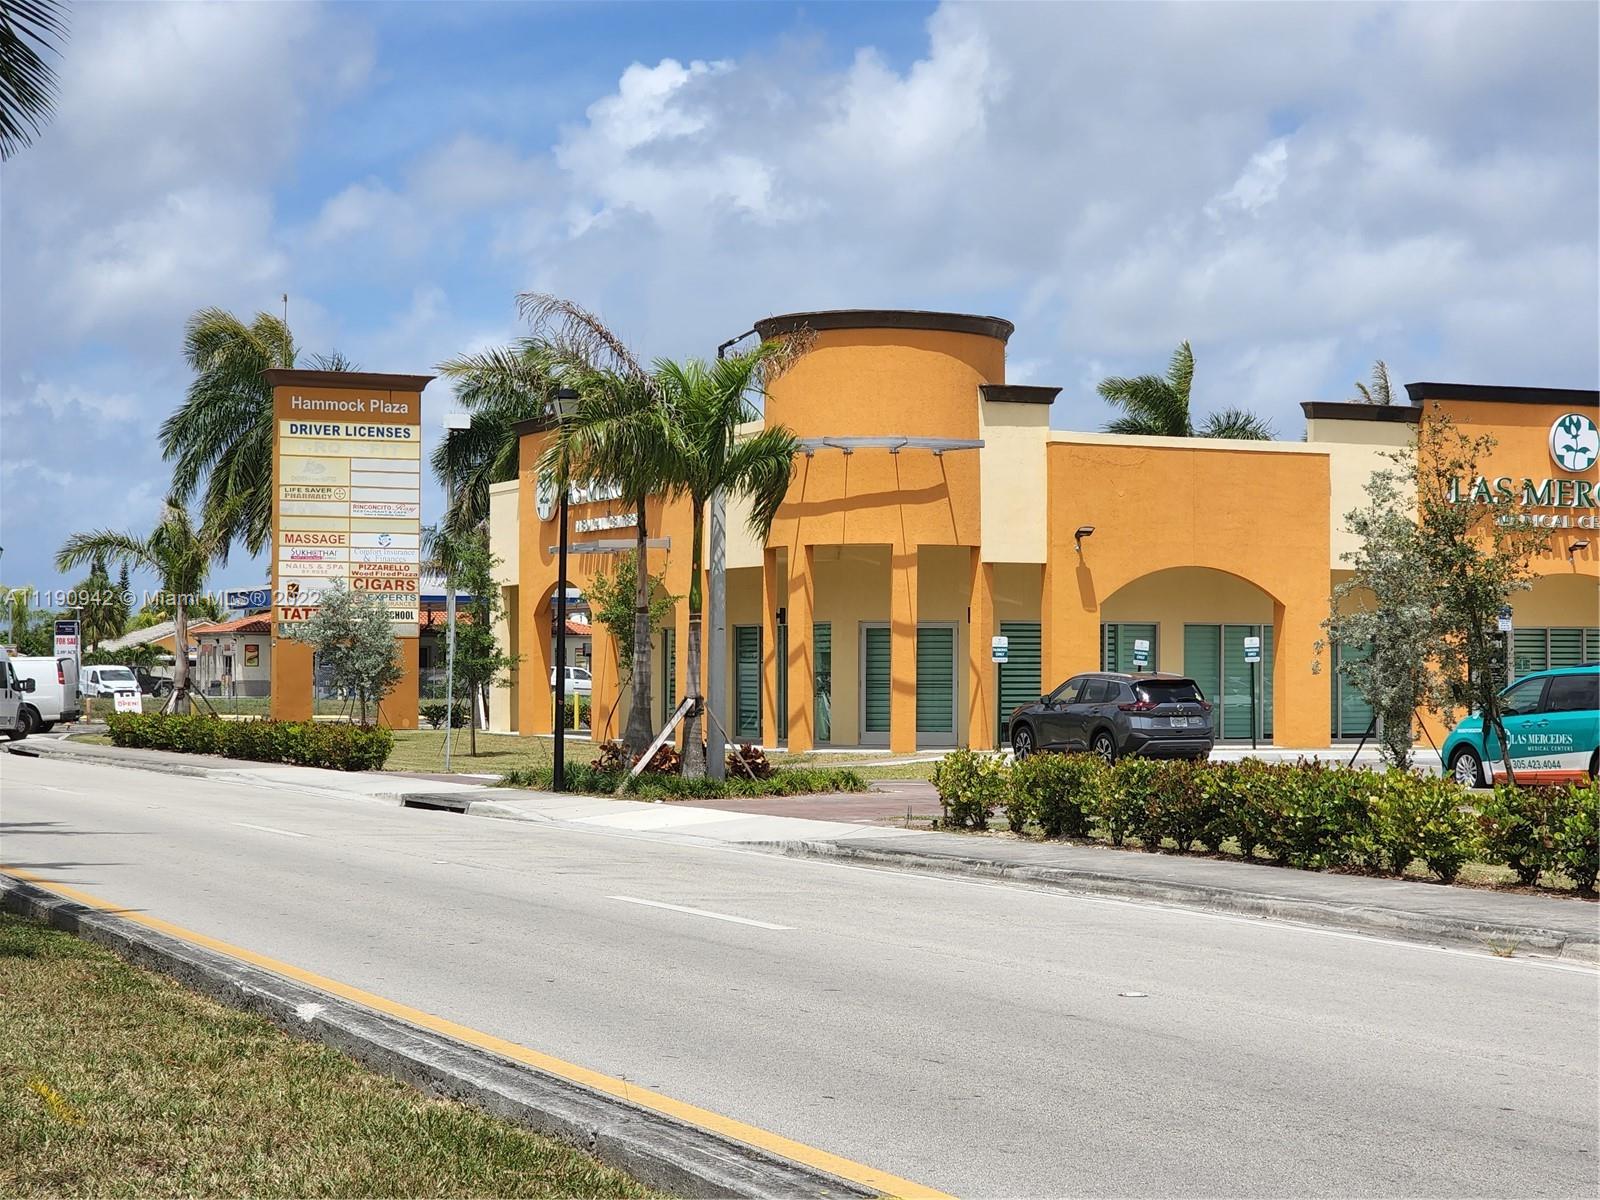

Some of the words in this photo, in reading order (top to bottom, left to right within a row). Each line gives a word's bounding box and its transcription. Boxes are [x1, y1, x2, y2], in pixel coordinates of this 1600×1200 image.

[291, 396, 365, 412] Hammock
[370, 400, 409, 414] Plaza
[290, 424, 340, 436] DRIVER
[345, 426, 411, 439] LICENSES
[1448, 475, 1514, 505] LAS
[284, 533, 346, 545] MASSAGE
[358, 563, 410, 571] PIZZARELLO
[353, 578, 416, 591] CIGARS
[367, 593, 417, 602] EXPERTS
[281, 607, 320, 620] TAT
[56, 637, 66, 645] FOR
[1511, 733, 1527, 744] LAS
[1528, 733, 1573, 745] MERCEDES
[1512, 759, 1562, 770] 305.423.4044
